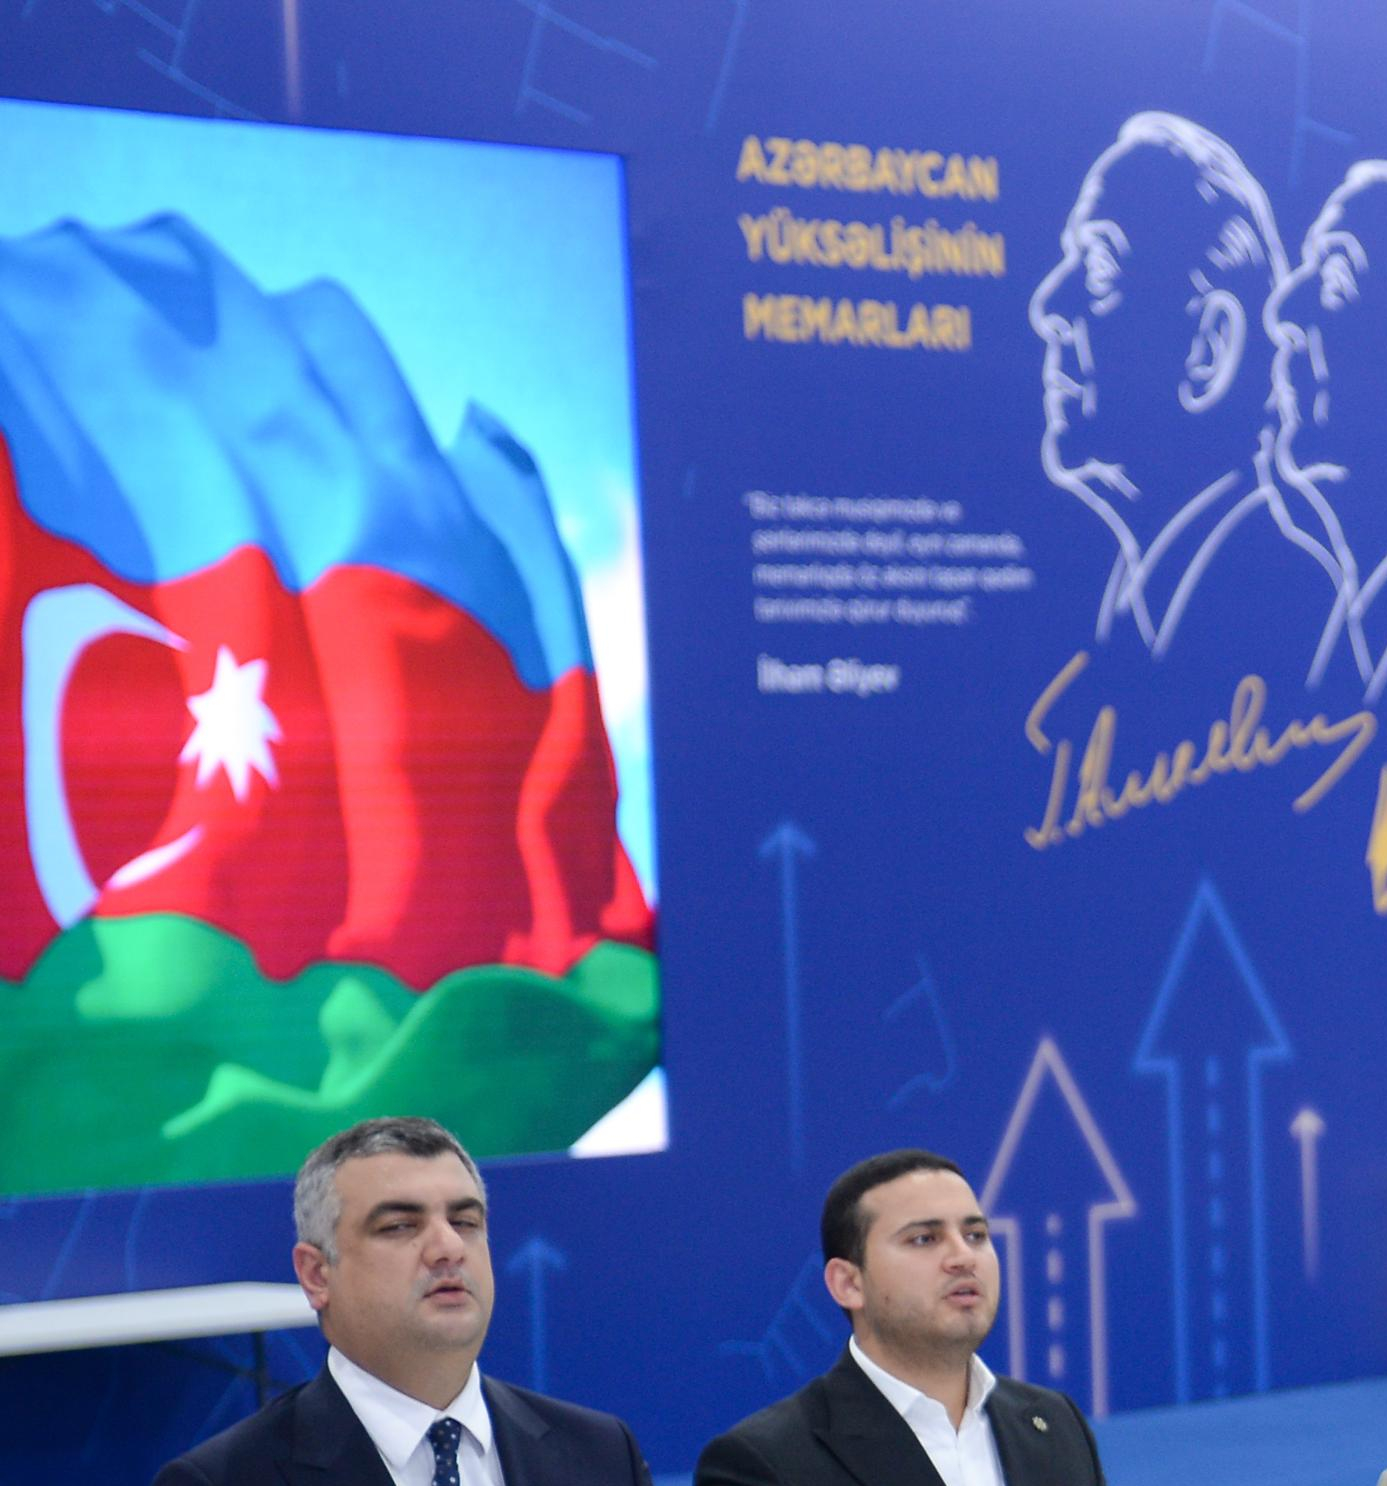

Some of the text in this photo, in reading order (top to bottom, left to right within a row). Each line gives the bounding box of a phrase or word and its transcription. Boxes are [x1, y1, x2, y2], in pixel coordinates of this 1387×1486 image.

[738, 135, 999, 203] AZƏRBAYCAN
[738, 206, 1006, 281] YÜKSƏLİŞİNİN
[743, 292, 973, 351] MEMARLARI
